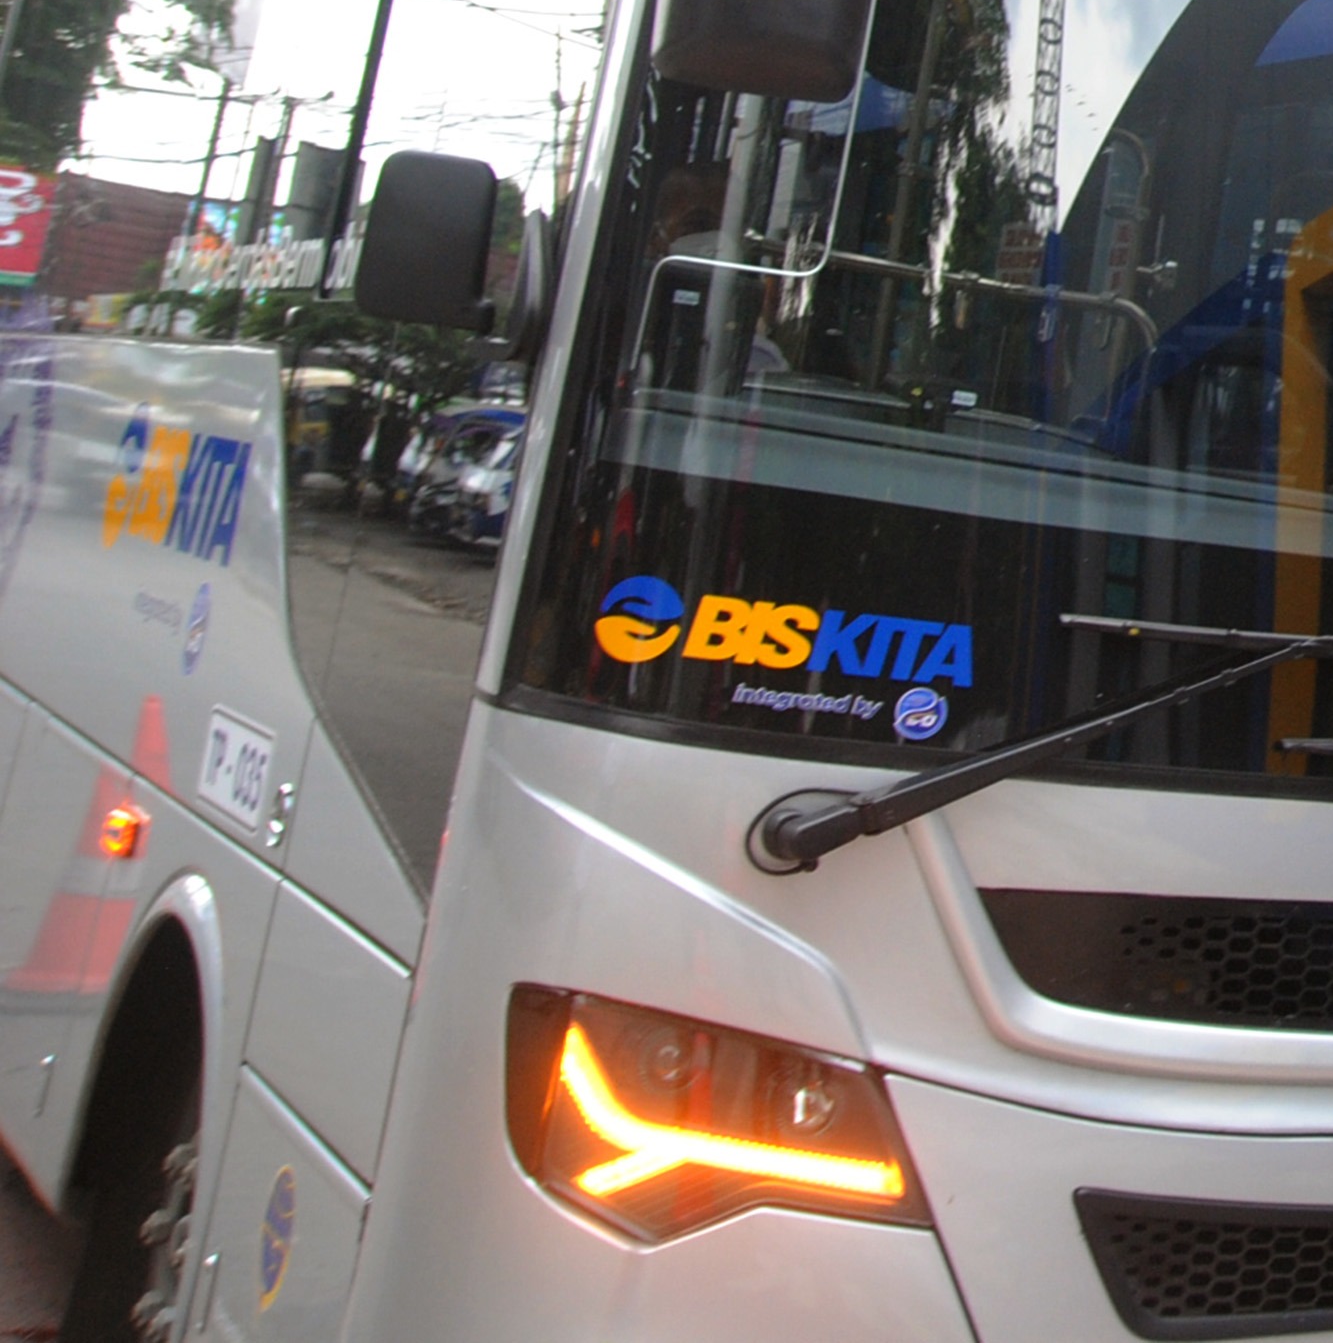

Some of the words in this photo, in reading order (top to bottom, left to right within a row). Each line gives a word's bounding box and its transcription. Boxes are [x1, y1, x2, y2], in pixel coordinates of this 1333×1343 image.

[682, 594, 974, 688] BISKITA
[731, 682, 853, 712] integrated
[851, 695, 885, 720] by
